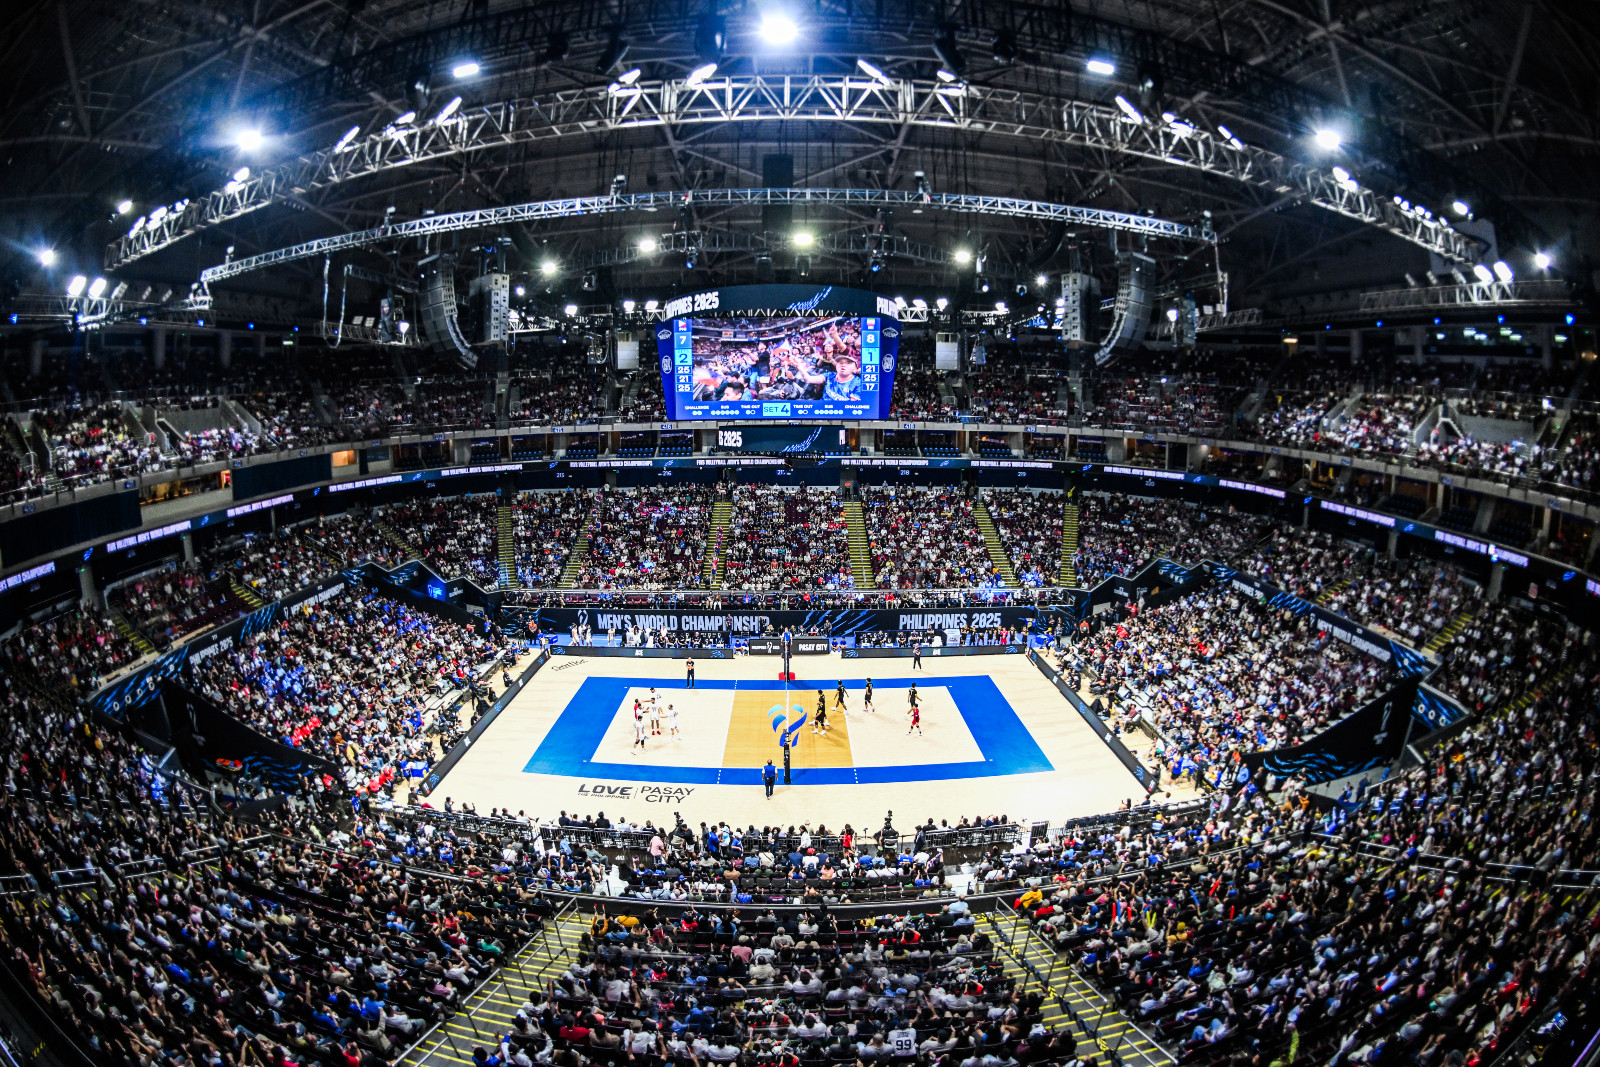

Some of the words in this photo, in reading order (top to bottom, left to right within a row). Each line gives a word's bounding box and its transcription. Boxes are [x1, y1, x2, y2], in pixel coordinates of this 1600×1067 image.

[679, 335, 687, 345] 7
[866, 333, 875, 343] 8
[679, 353, 688, 363] 2
[867, 352, 873, 362] 1
[677, 366, 690, 374] 25
[864, 374, 877, 382] 25
[678, 384, 690, 392] 25
[866, 383, 875, 391] 17
[780, 404, 790, 414] 4
[597, 613, 632, 629] MEN'S
[635, 614, 679, 631] WORLD
[899, 613, 968, 630] PHILIPPINES
[971, 612, 1002, 629] 2025
[798, 643, 815, 651] PASAY
[815, 643, 828, 651] CITY
[578, 784, 633, 796] LOVE
[640, 785, 695, 796] PASAY
[645, 794, 686, 804] CITY
[896, 1039, 912, 1051] 99
